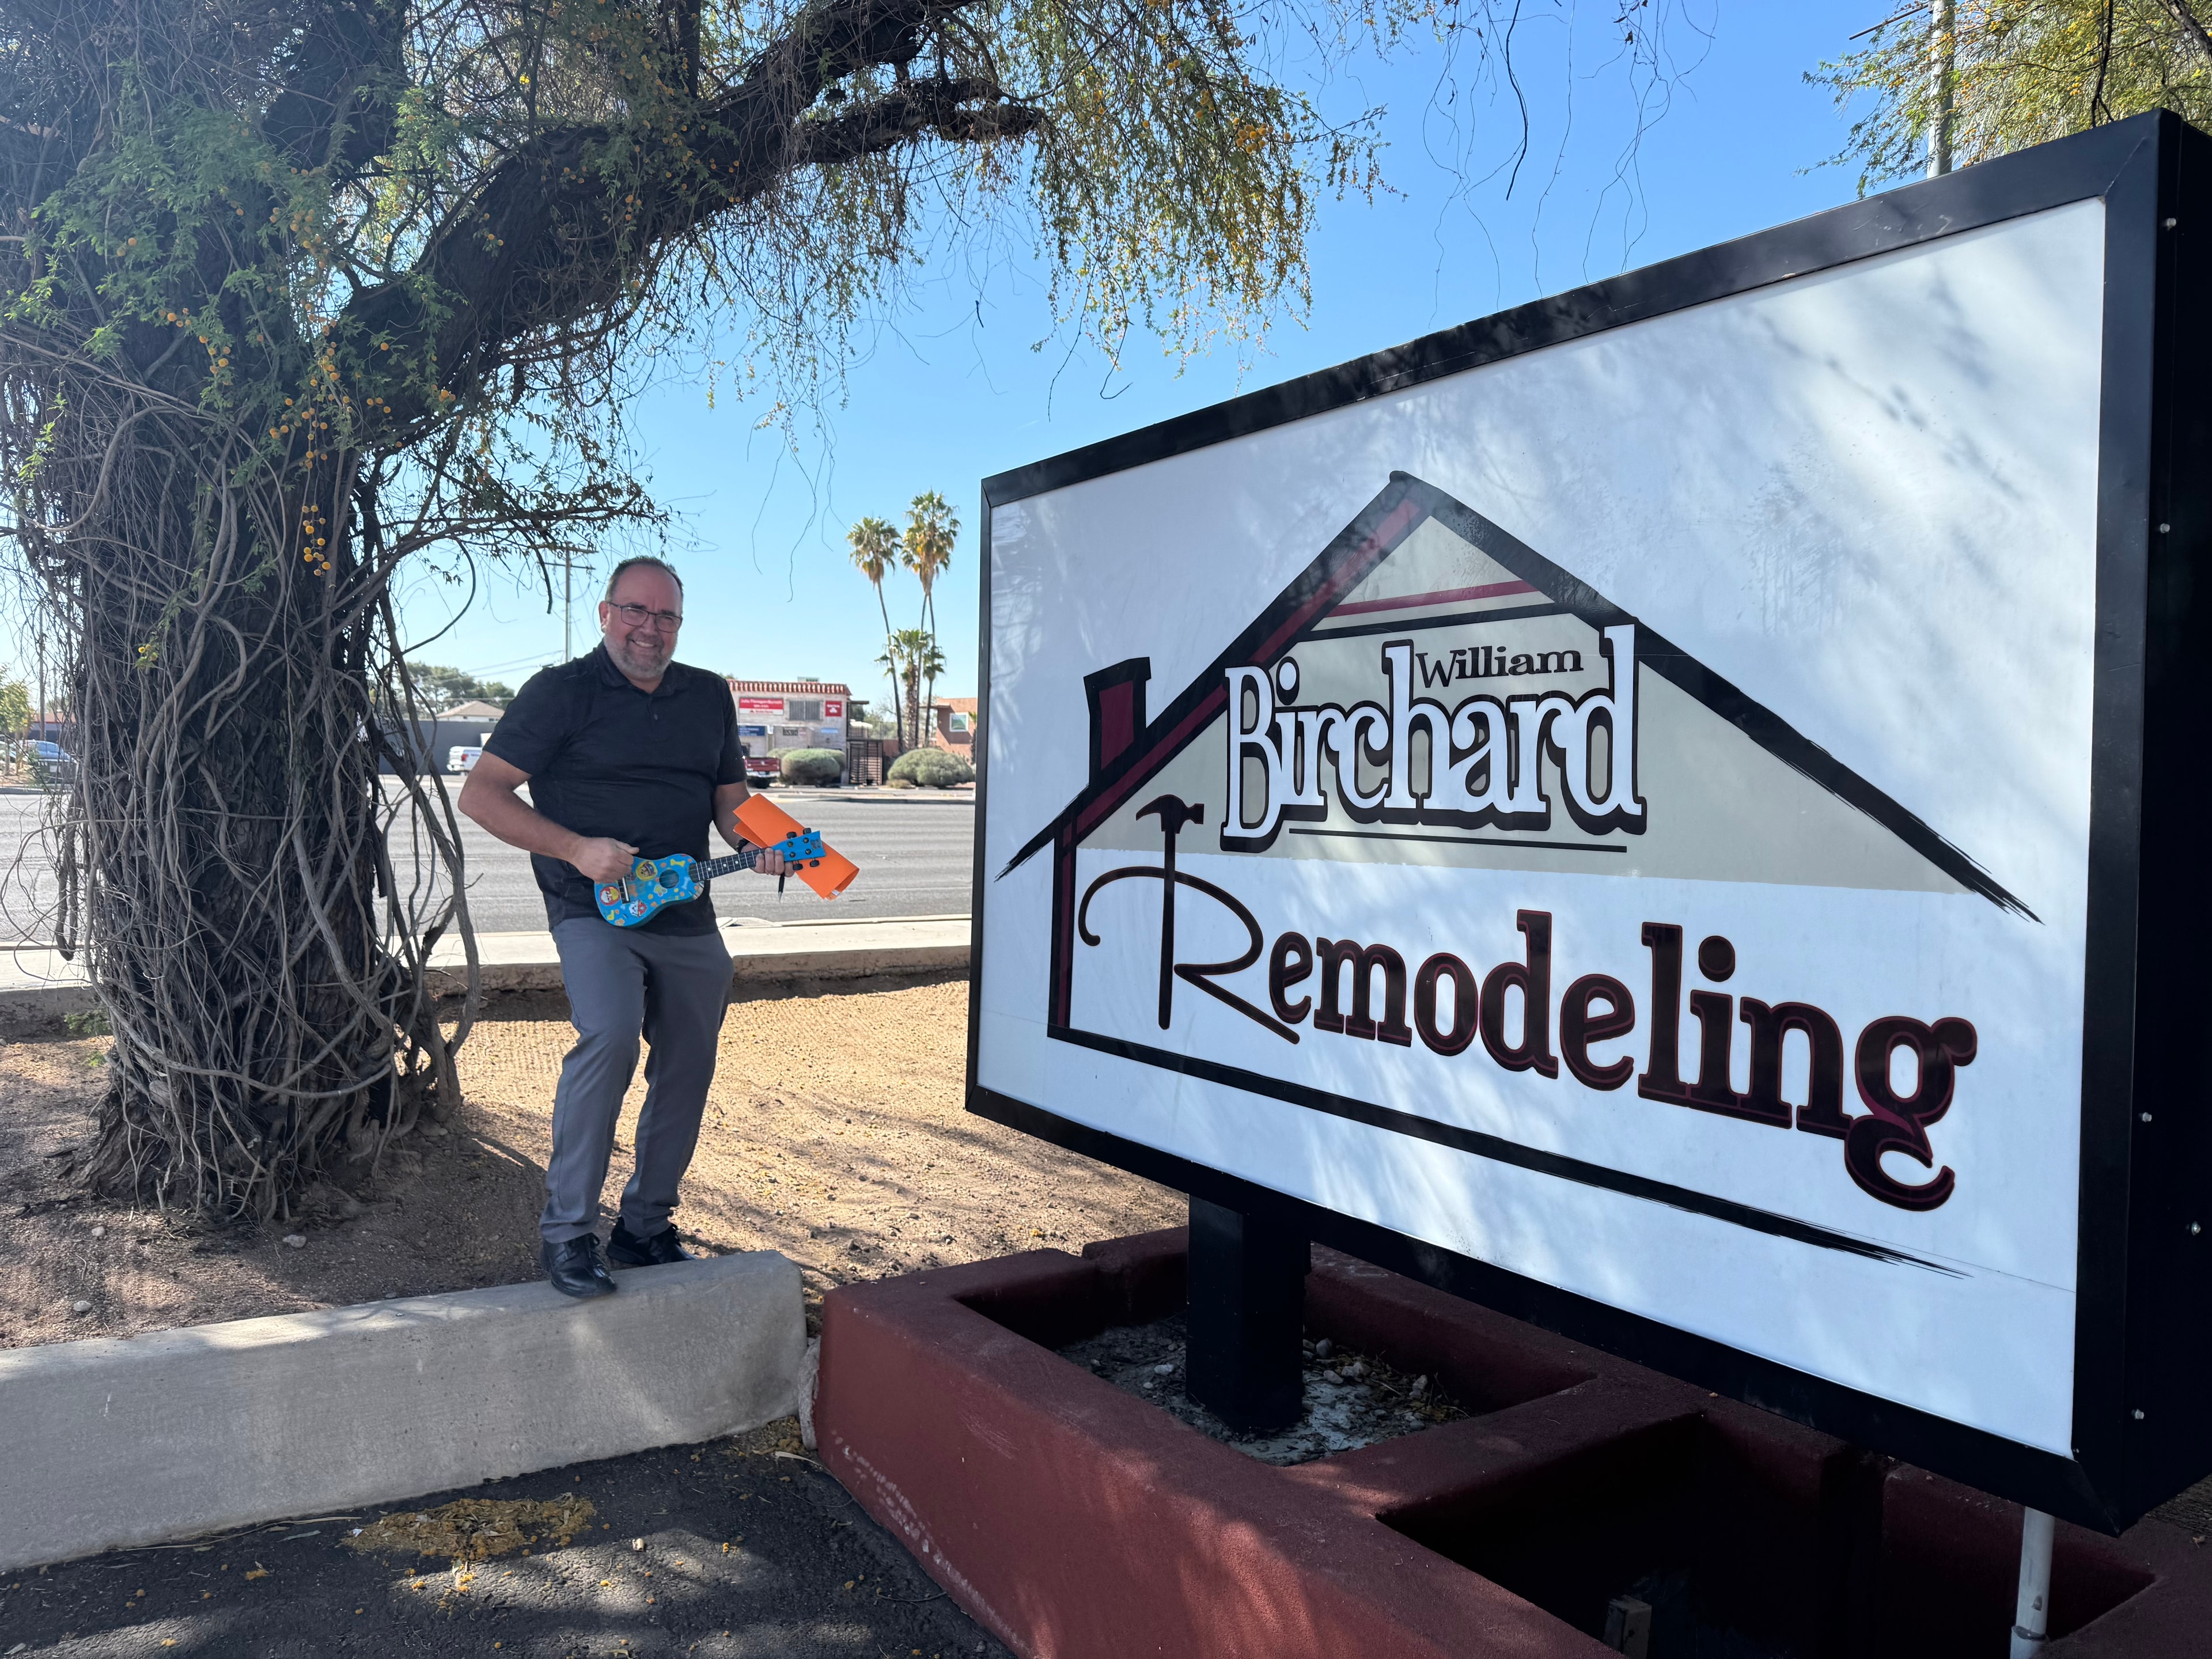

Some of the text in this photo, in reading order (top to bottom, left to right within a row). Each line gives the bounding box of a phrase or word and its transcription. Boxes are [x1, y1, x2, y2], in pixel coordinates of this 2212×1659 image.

[1219, 616, 1647, 853] Birchard
[1415, 645, 1584, 688] William
[1078, 795, 1978, 1211] Remodeling
